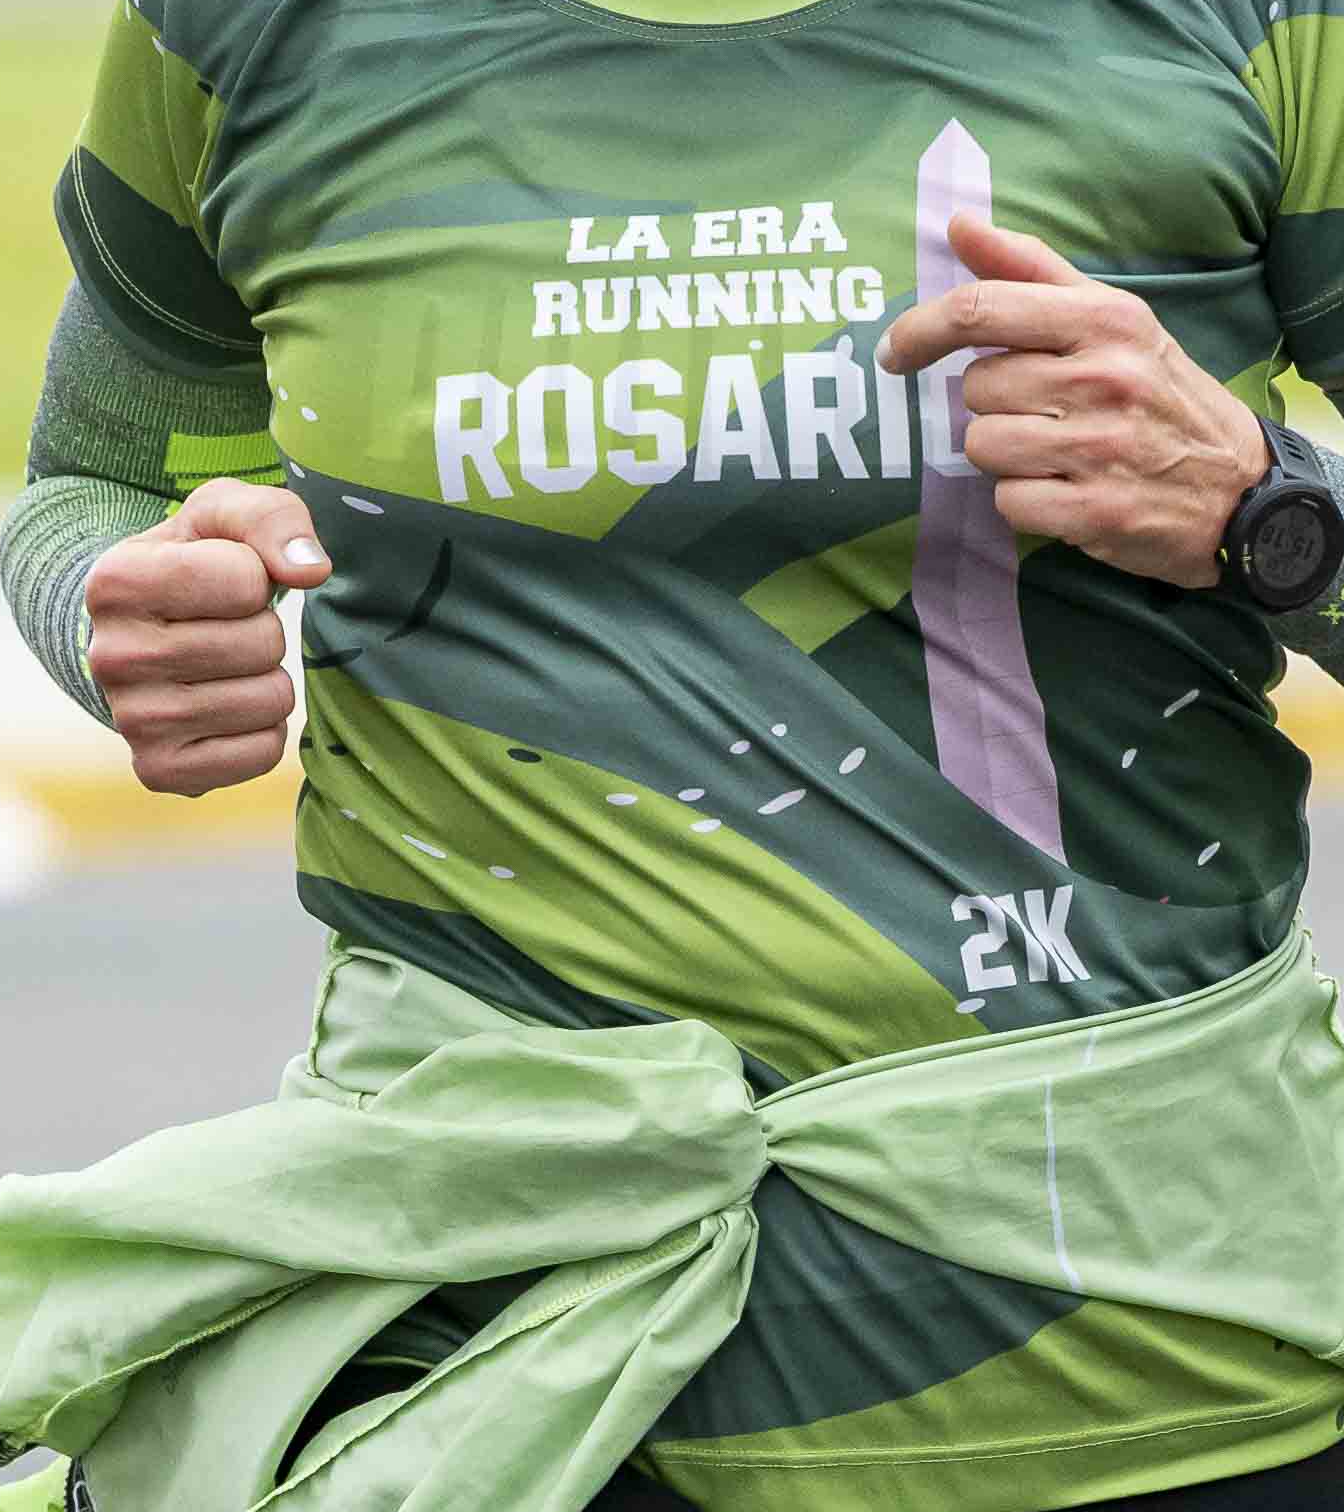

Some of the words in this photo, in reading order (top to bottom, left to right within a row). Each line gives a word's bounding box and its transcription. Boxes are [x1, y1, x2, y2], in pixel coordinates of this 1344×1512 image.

[567, 215, 670, 264] LA
[690, 201, 848, 257] ERA
[531, 265, 886, 338] RUNNING
